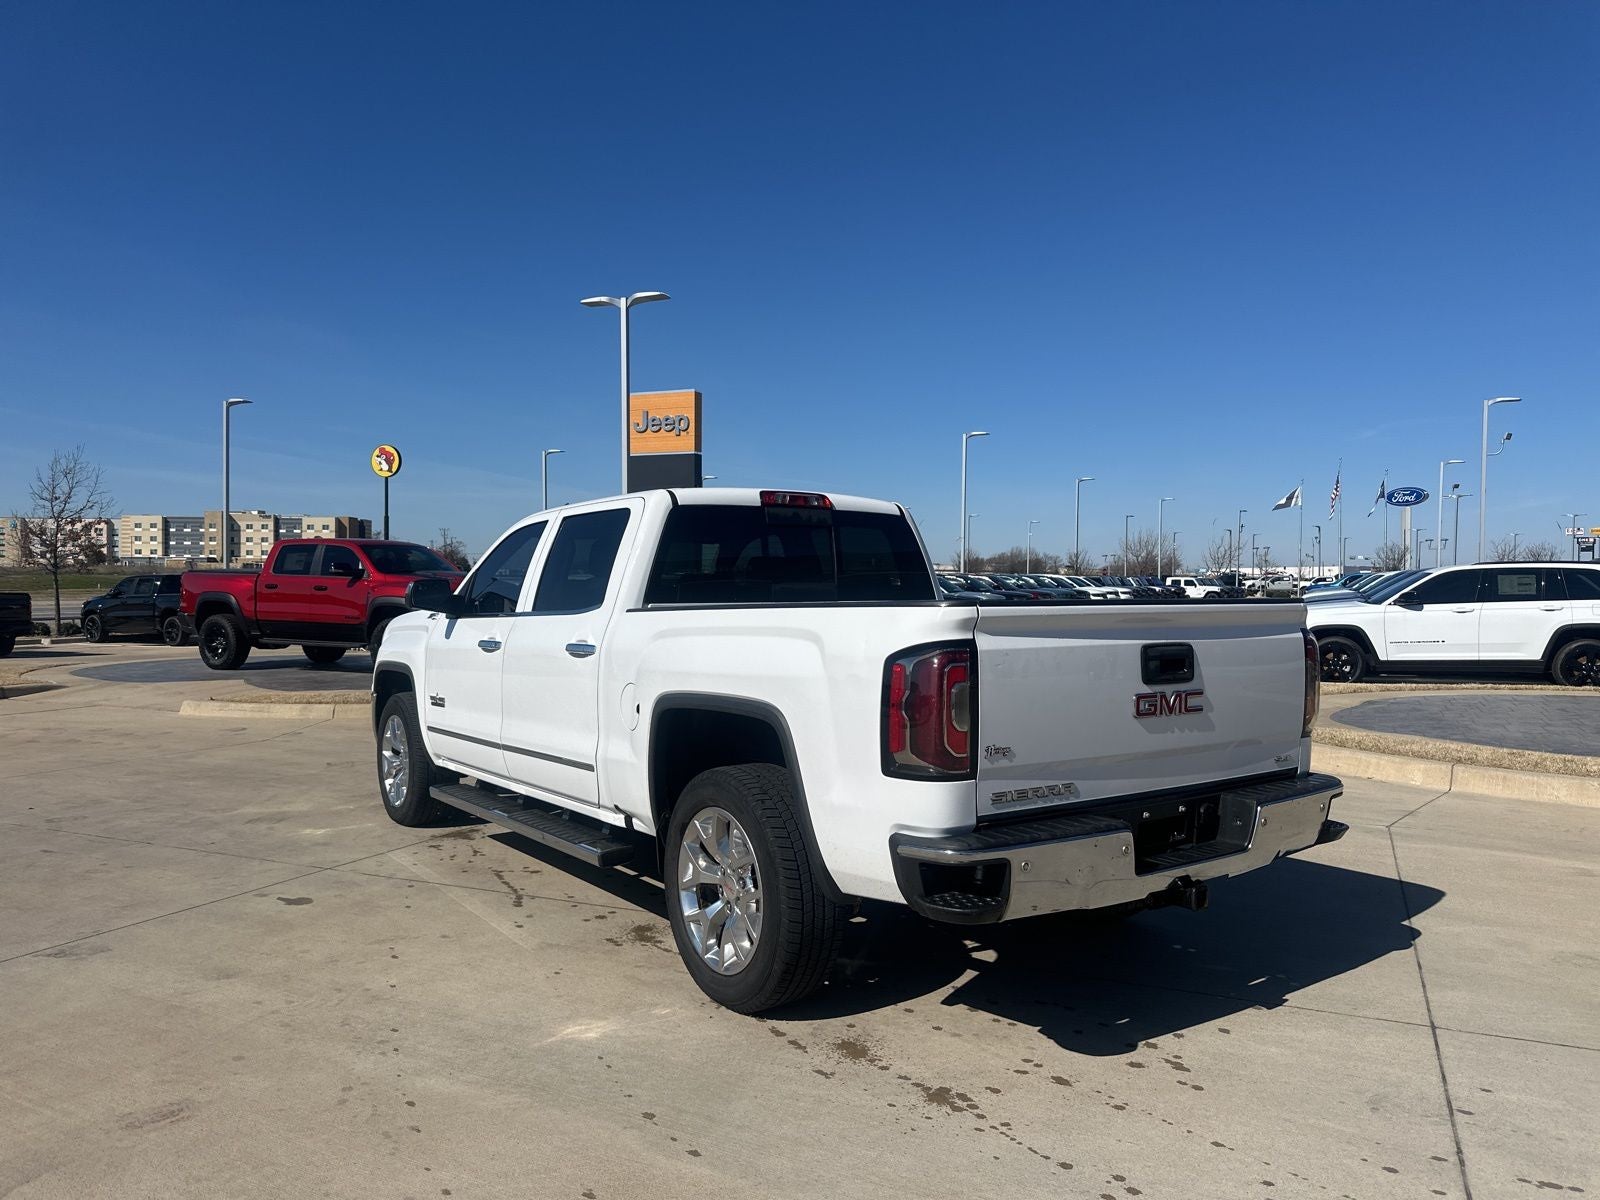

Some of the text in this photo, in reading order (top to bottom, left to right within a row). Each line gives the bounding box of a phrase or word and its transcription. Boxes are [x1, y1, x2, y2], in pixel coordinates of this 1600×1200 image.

[633, 410, 690, 436] Jeep
[1391, 490, 1417, 503] Ford
[1133, 689, 1204, 719] GMC
[990, 782, 1076, 806] SIERRA
